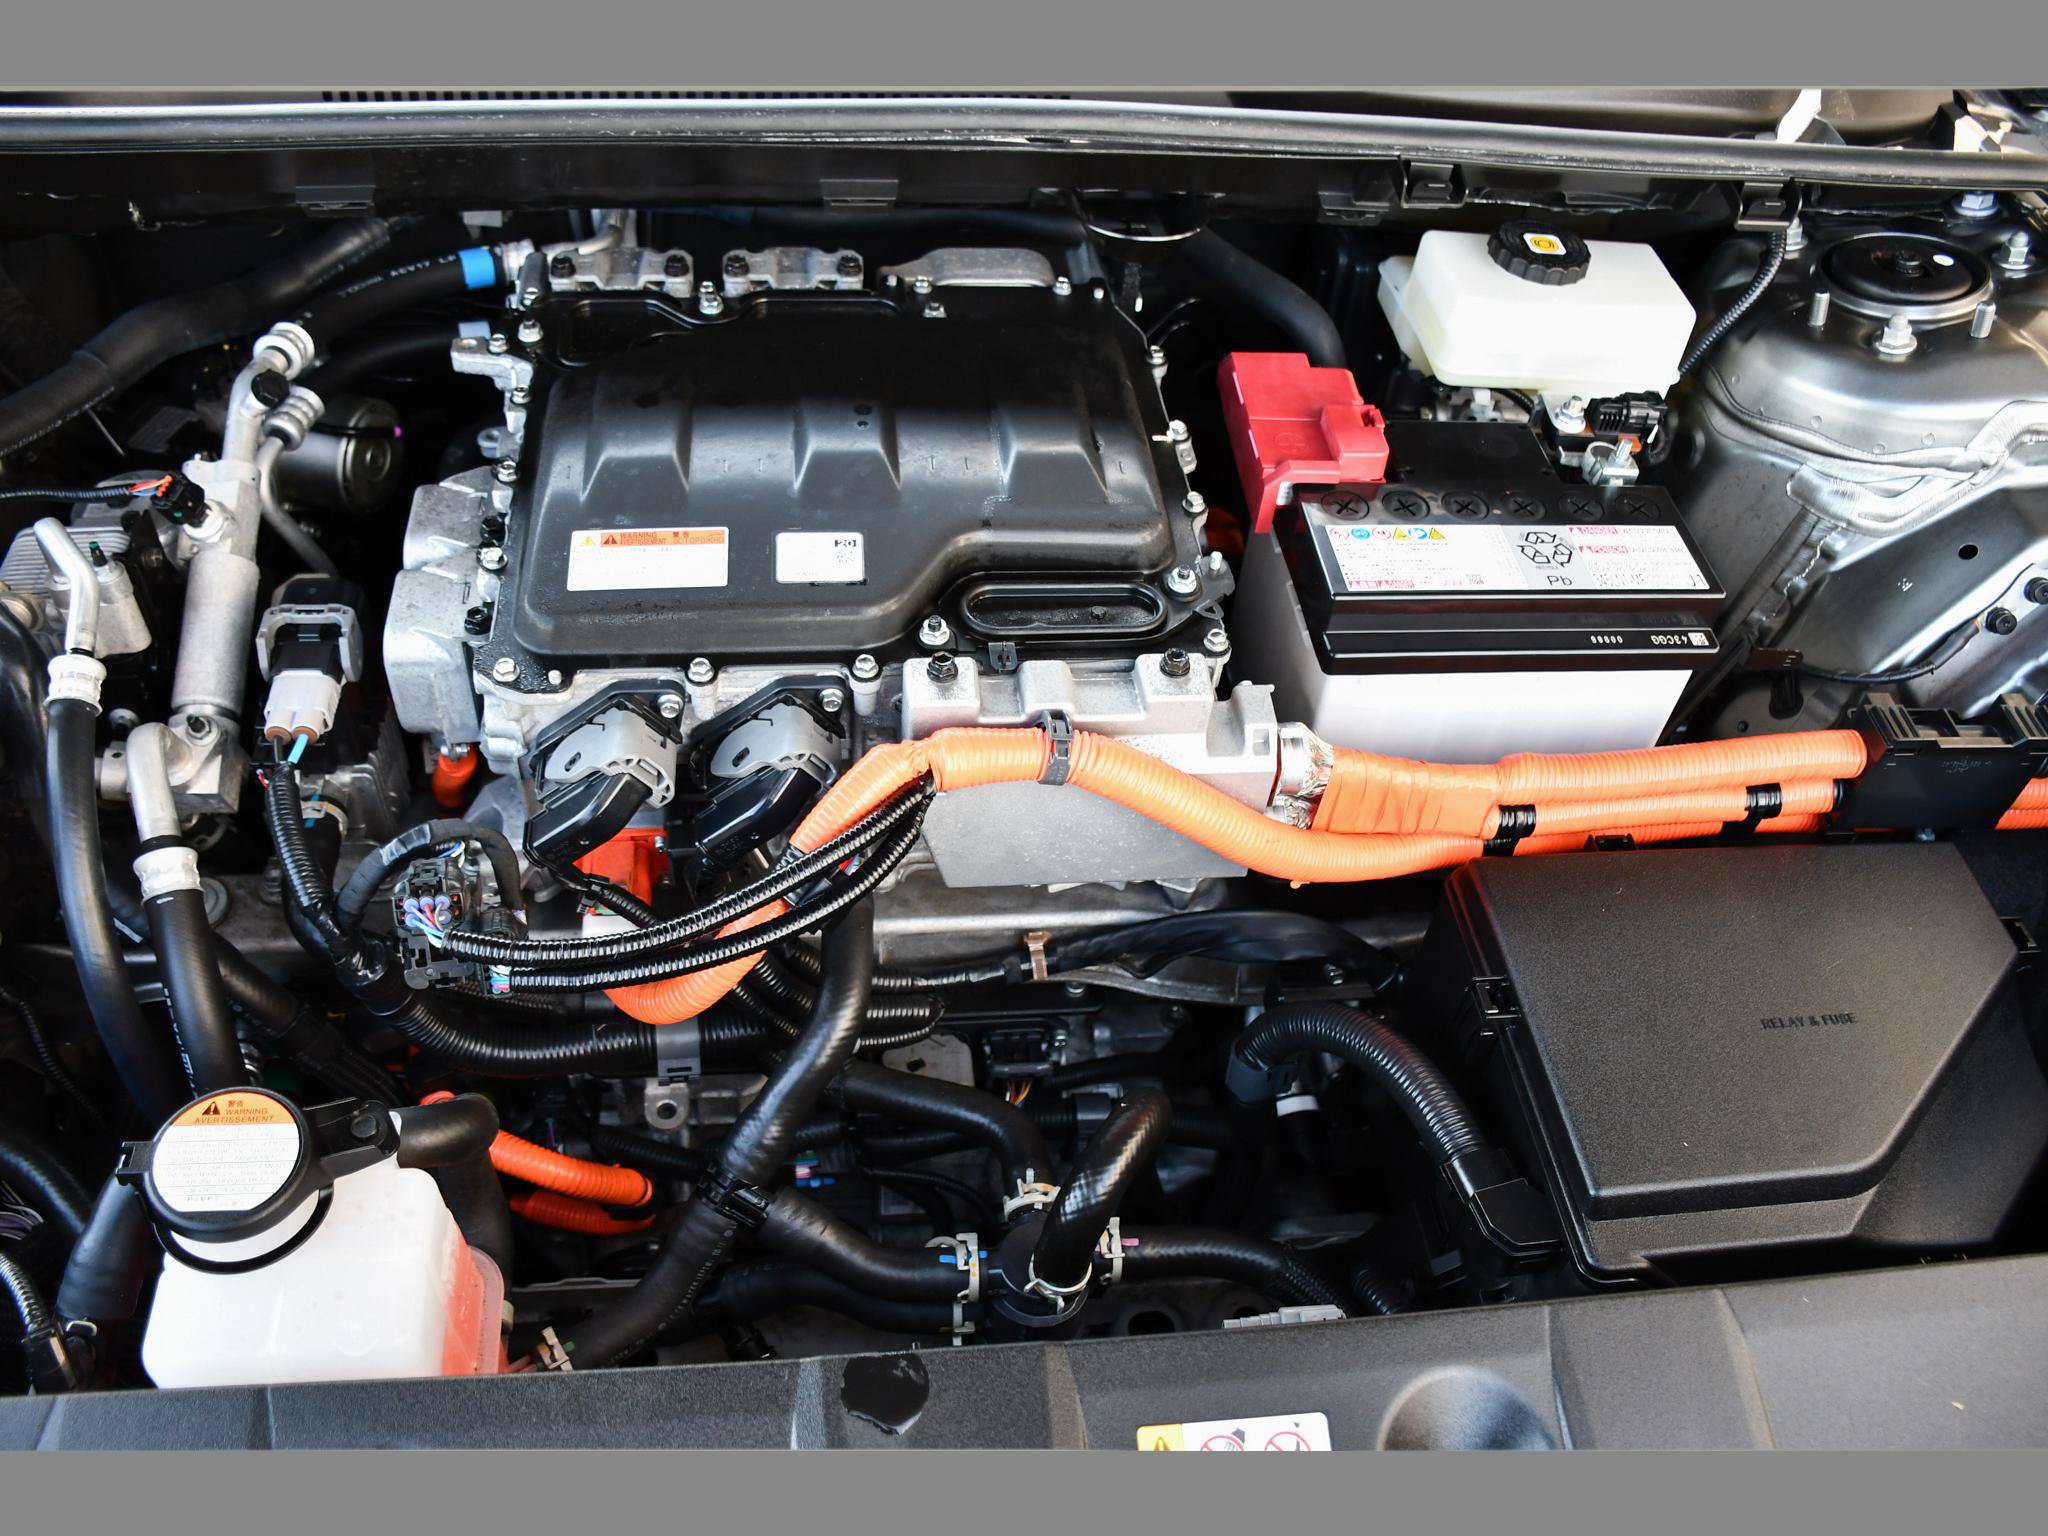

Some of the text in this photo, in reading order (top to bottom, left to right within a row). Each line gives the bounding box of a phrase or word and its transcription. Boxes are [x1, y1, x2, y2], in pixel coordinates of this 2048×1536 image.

[1547, 575, 1573, 586] Pb
[1761, 1012, 1857, 1029] RELAY & FUSE
[225, 1107, 268, 1116] WARNING
[194, 1115, 274, 1124] AVERTISSEMENT
